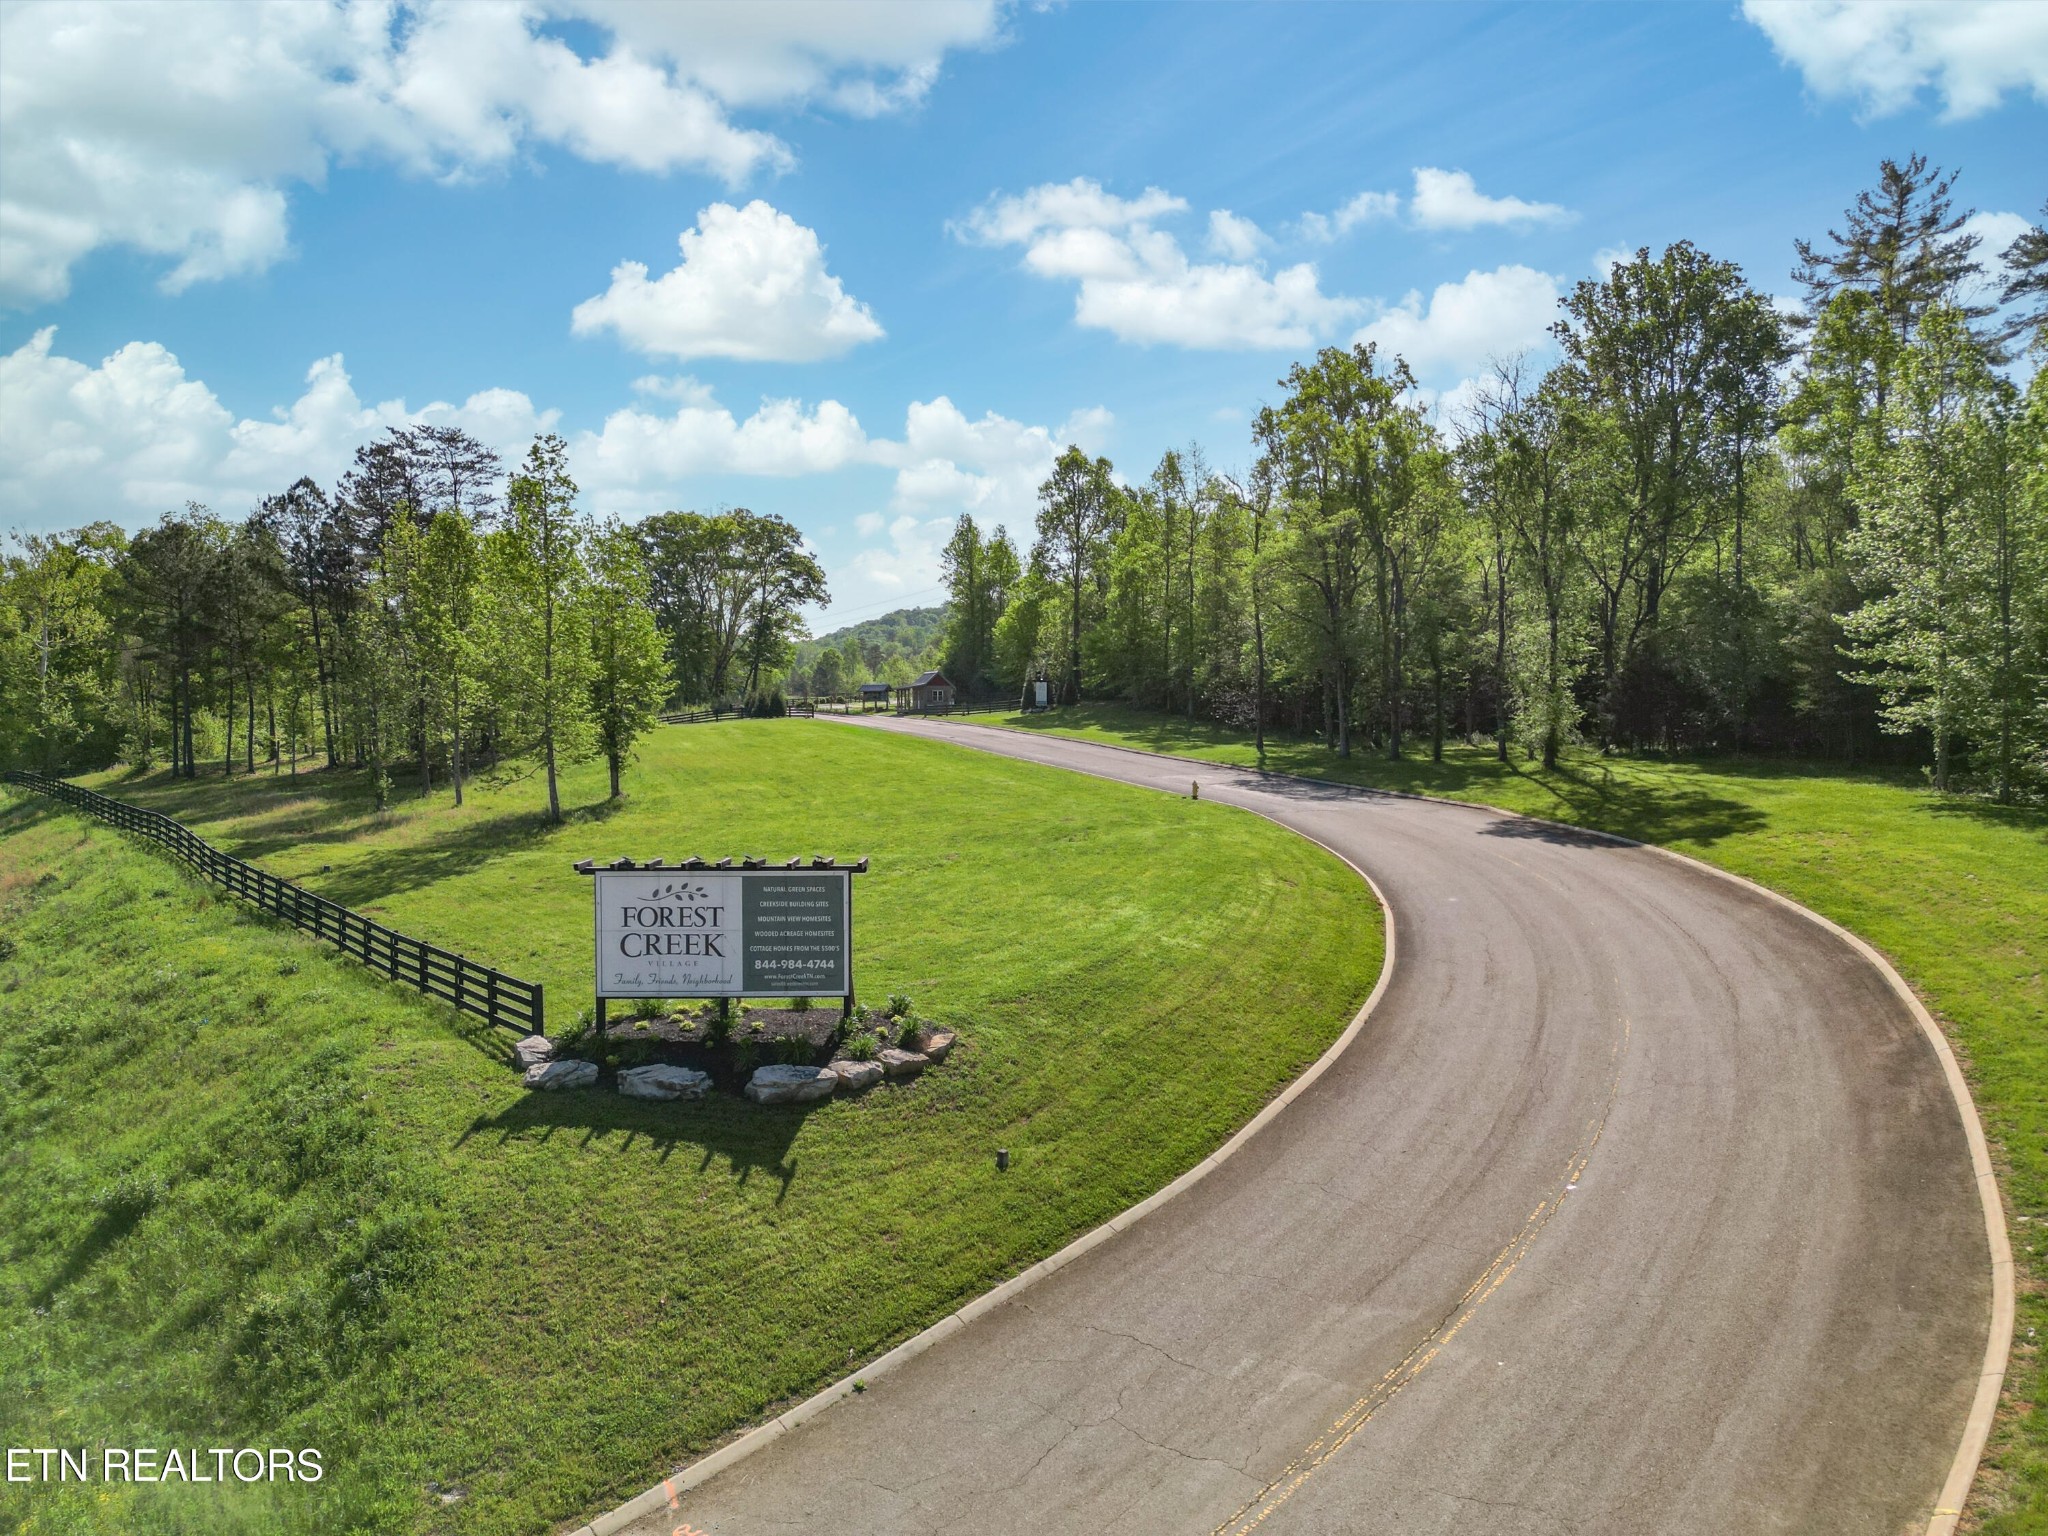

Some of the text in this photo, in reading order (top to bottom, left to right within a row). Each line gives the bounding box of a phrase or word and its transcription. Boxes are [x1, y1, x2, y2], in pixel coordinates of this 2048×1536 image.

[620, 906, 725, 928] FOREST
[757, 915, 832, 923] MOUNTAIN VIEW HOMESITES
[754, 930, 835, 938] WOODED ACREAGE HOMESITES
[619, 932, 726, 958] CREEK
[754, 959, 835, 970] 844-984-4744
[613, 973, 733, 987] Family, Friends, Neighborhood
